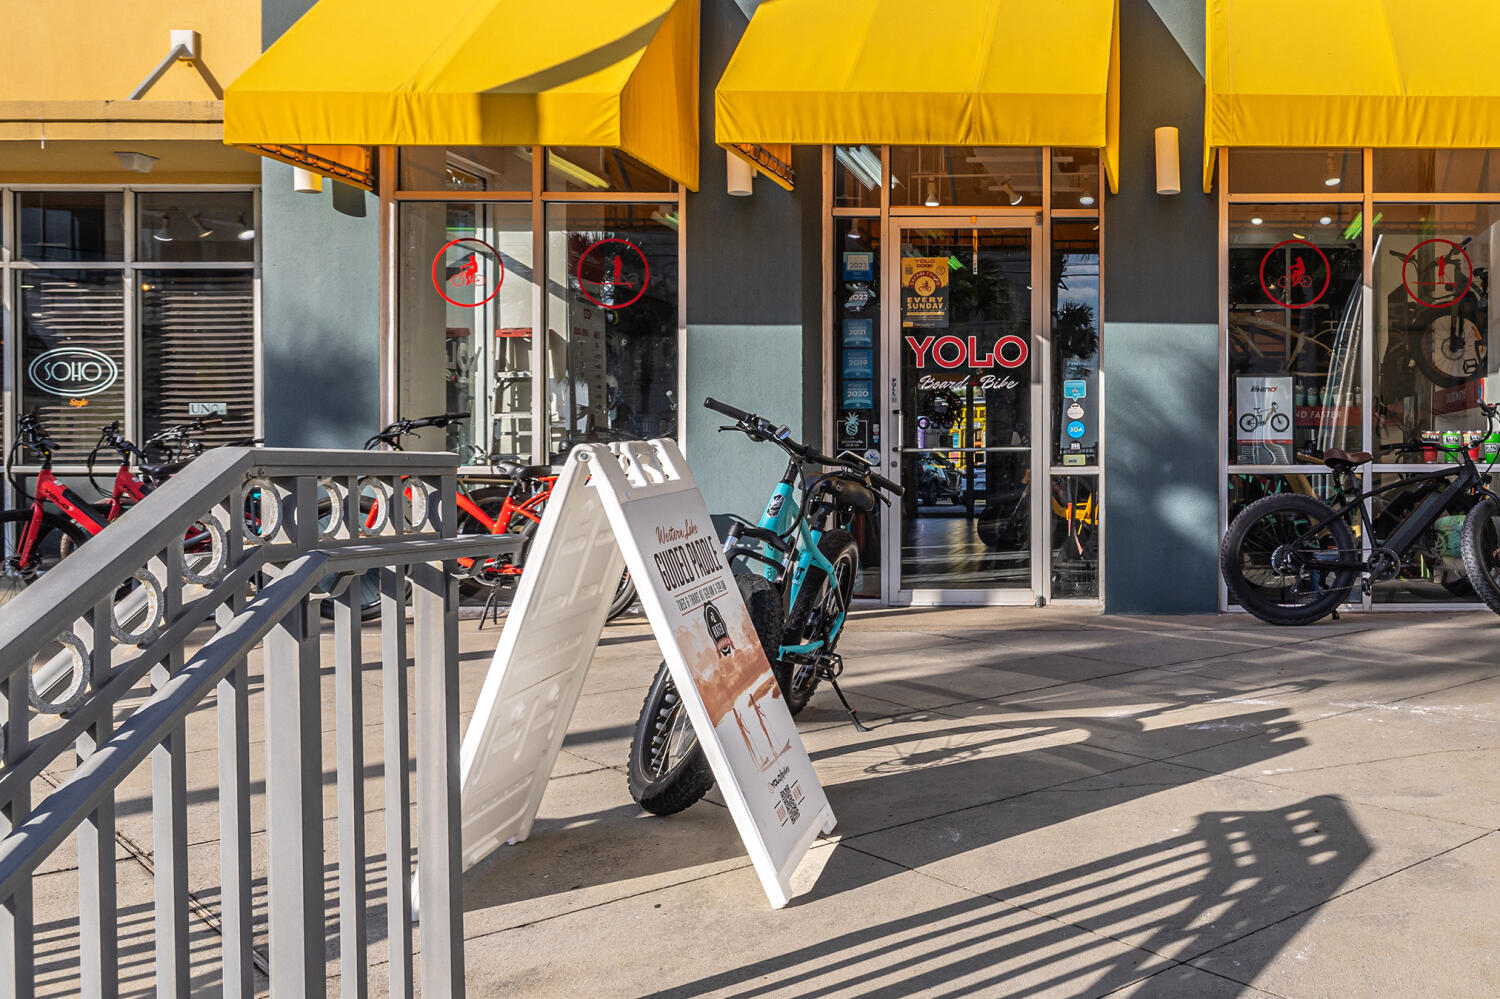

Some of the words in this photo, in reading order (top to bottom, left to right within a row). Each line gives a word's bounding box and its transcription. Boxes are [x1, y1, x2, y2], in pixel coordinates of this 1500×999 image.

[905, 334, 1029, 369] YOLO
[44, 361, 102, 382] SOHO
[919, 374, 970, 391] Board
[980, 374, 1019, 390] Bike
[655, 525, 684, 545] Western
[654, 545, 695, 592] GUIDED
[687, 535, 723, 580] PADDLE
